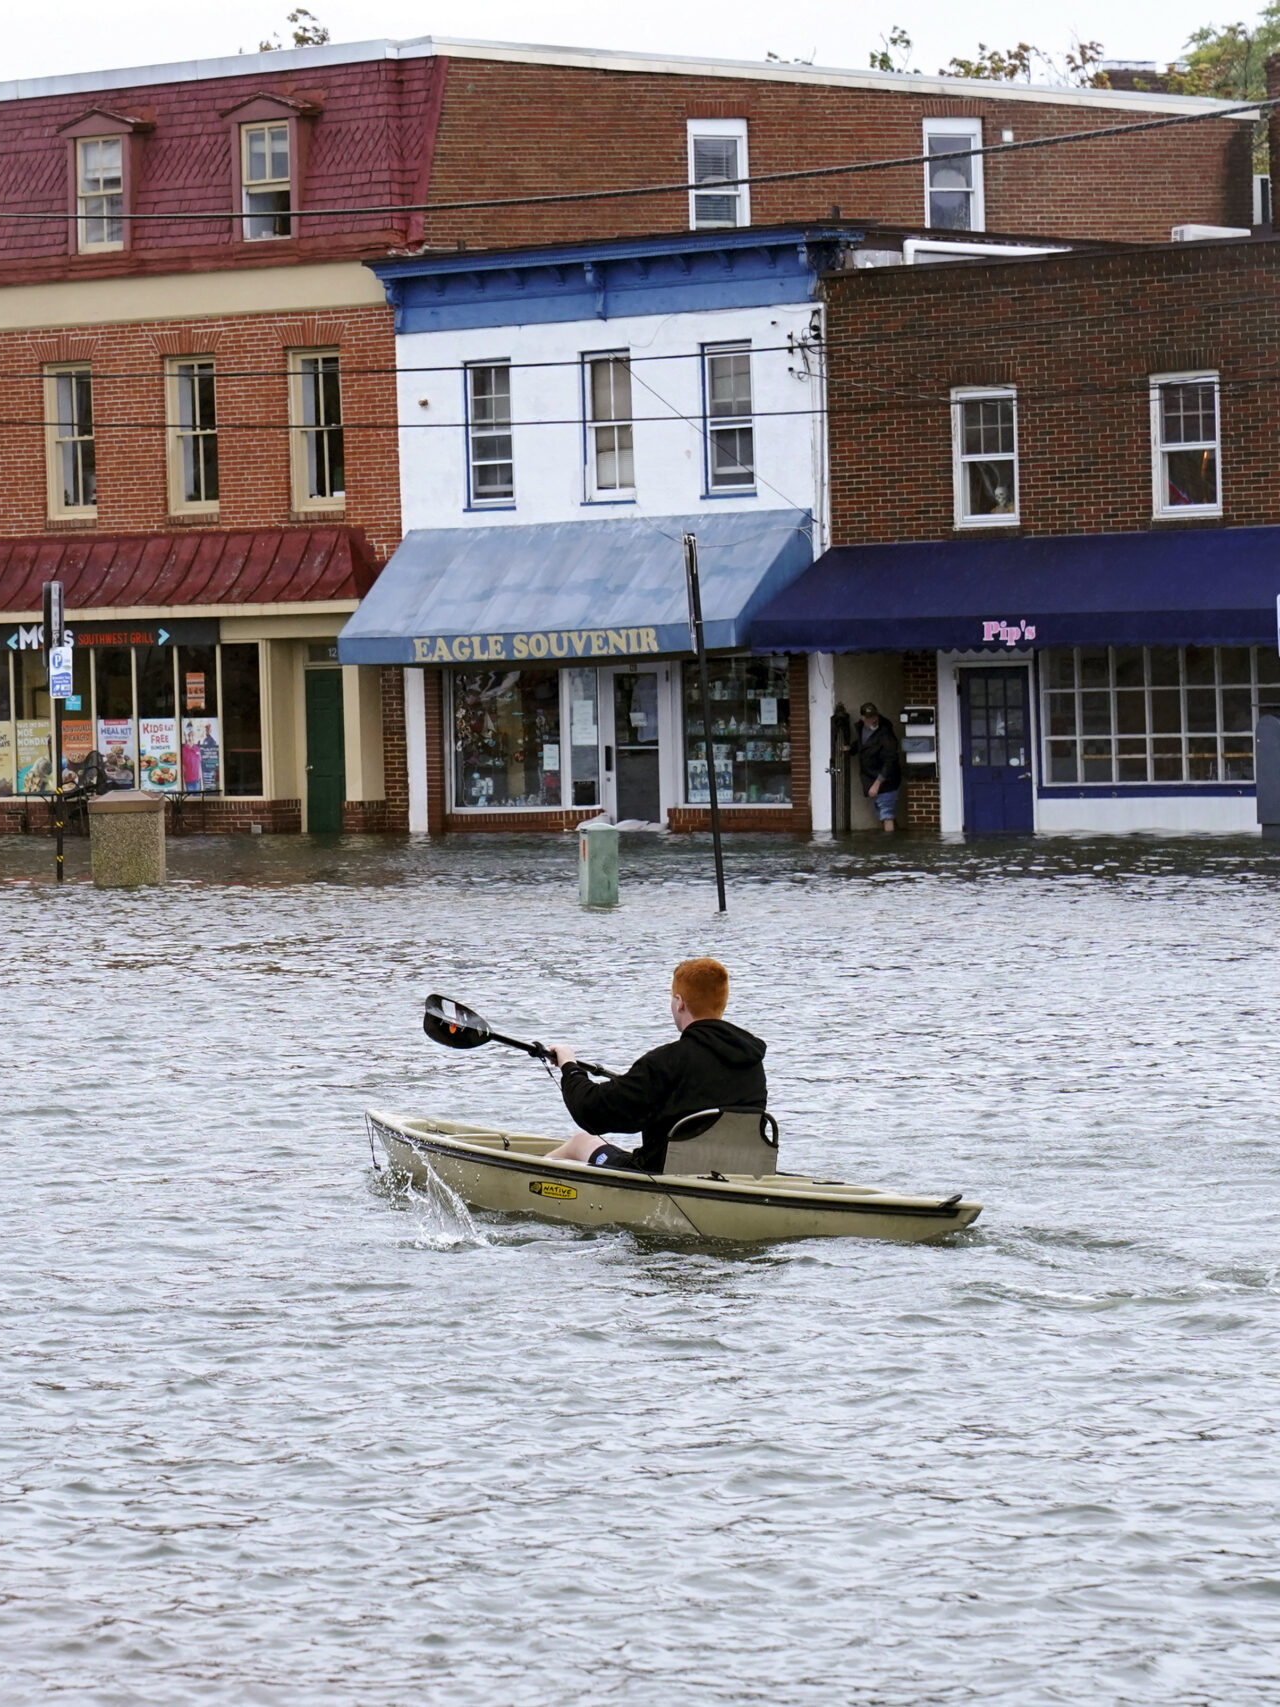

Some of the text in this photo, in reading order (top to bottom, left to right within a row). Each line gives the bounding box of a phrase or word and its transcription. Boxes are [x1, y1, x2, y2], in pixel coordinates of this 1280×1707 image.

[982, 619, 1036, 646] Pip's
[78, 632, 128, 646] SOUTHWEST
[130, 632, 154, 644] GRILL
[413, 628, 660, 662] EAGLE SOUVENIR
[17, 728, 34, 736] MOE
[100, 727, 132, 735] MEAL KIT
[143, 723, 164, 734] KIDS
[151, 735, 169, 743] FREE
[543, 1185, 572, 1195] NATIVE
